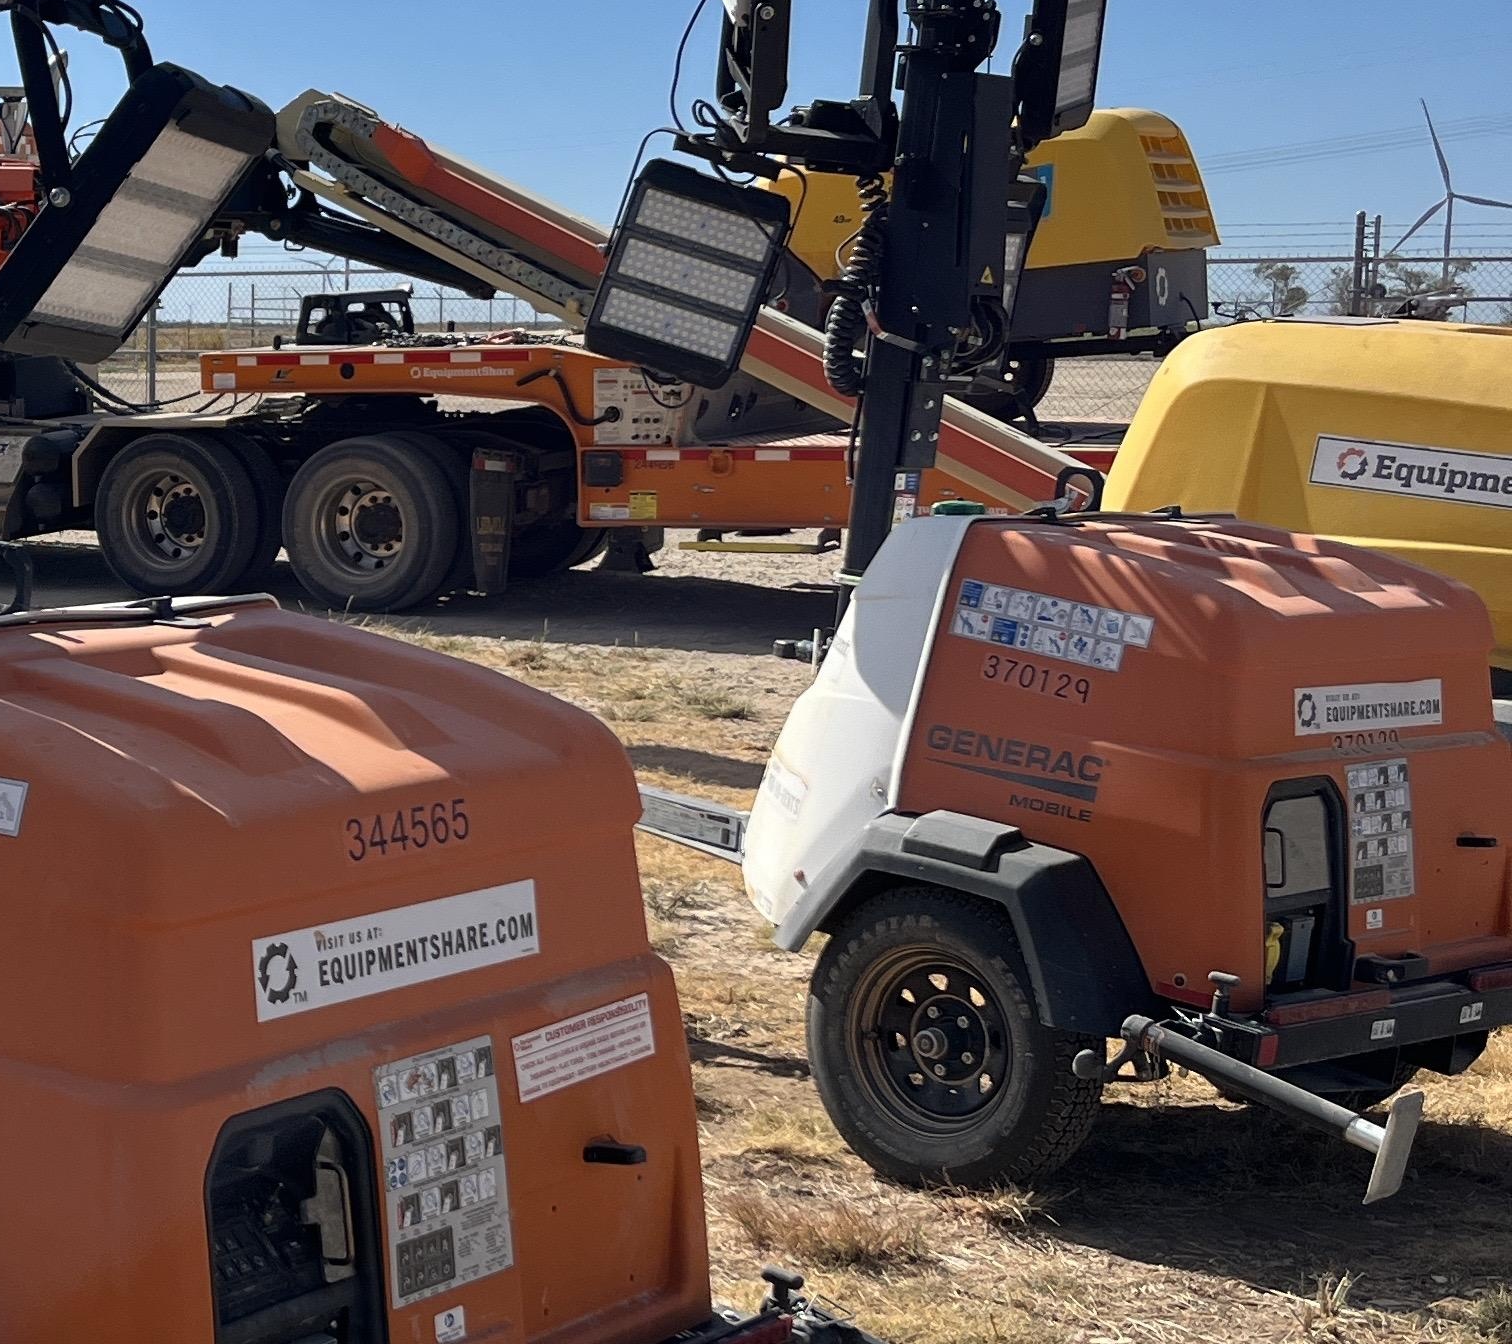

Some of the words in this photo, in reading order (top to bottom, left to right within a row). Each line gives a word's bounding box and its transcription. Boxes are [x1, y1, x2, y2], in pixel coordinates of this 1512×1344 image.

[983, 655, 1089, 704] 370129
[1326, 699, 1440, 723] EQUIPMENTSHARE.COM
[927, 724, 1104, 783] GENERAC
[346, 798, 468, 861] 344565
[1009, 794, 1093, 823] MOBILE
[318, 912, 534, 987] EQUIPMENTSHARE.COM
[348, 929, 363, 943] US
[544, 1019, 587, 1042] CUSTOMER
[587, 998, 647, 1027] RESPONSIBILITY
